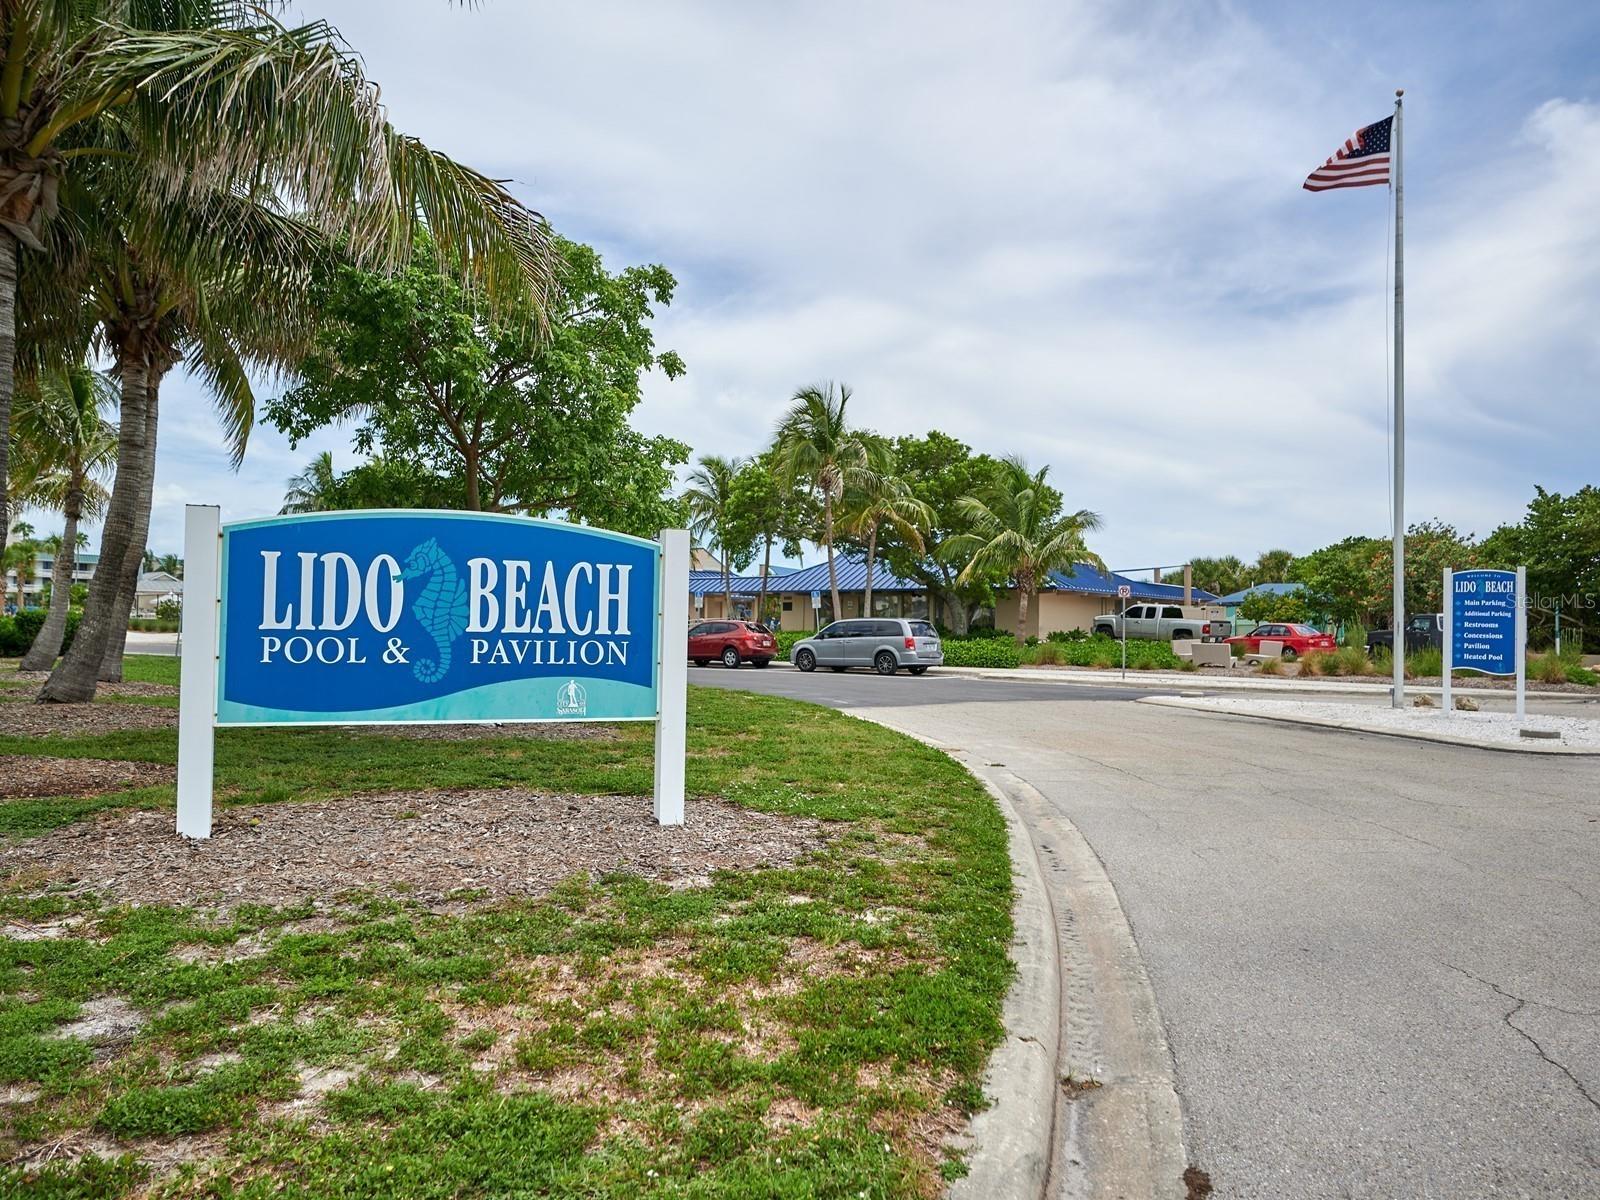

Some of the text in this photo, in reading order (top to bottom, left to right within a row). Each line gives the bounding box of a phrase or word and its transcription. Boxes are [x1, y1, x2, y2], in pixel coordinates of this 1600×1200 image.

[258, 550, 633, 637] LIDO BEACH
[1455, 581, 1514, 593] LIDO BEACH
[1481, 599, 1506, 607] Parking
[259, 636, 630, 666] POOL & PAVILION
